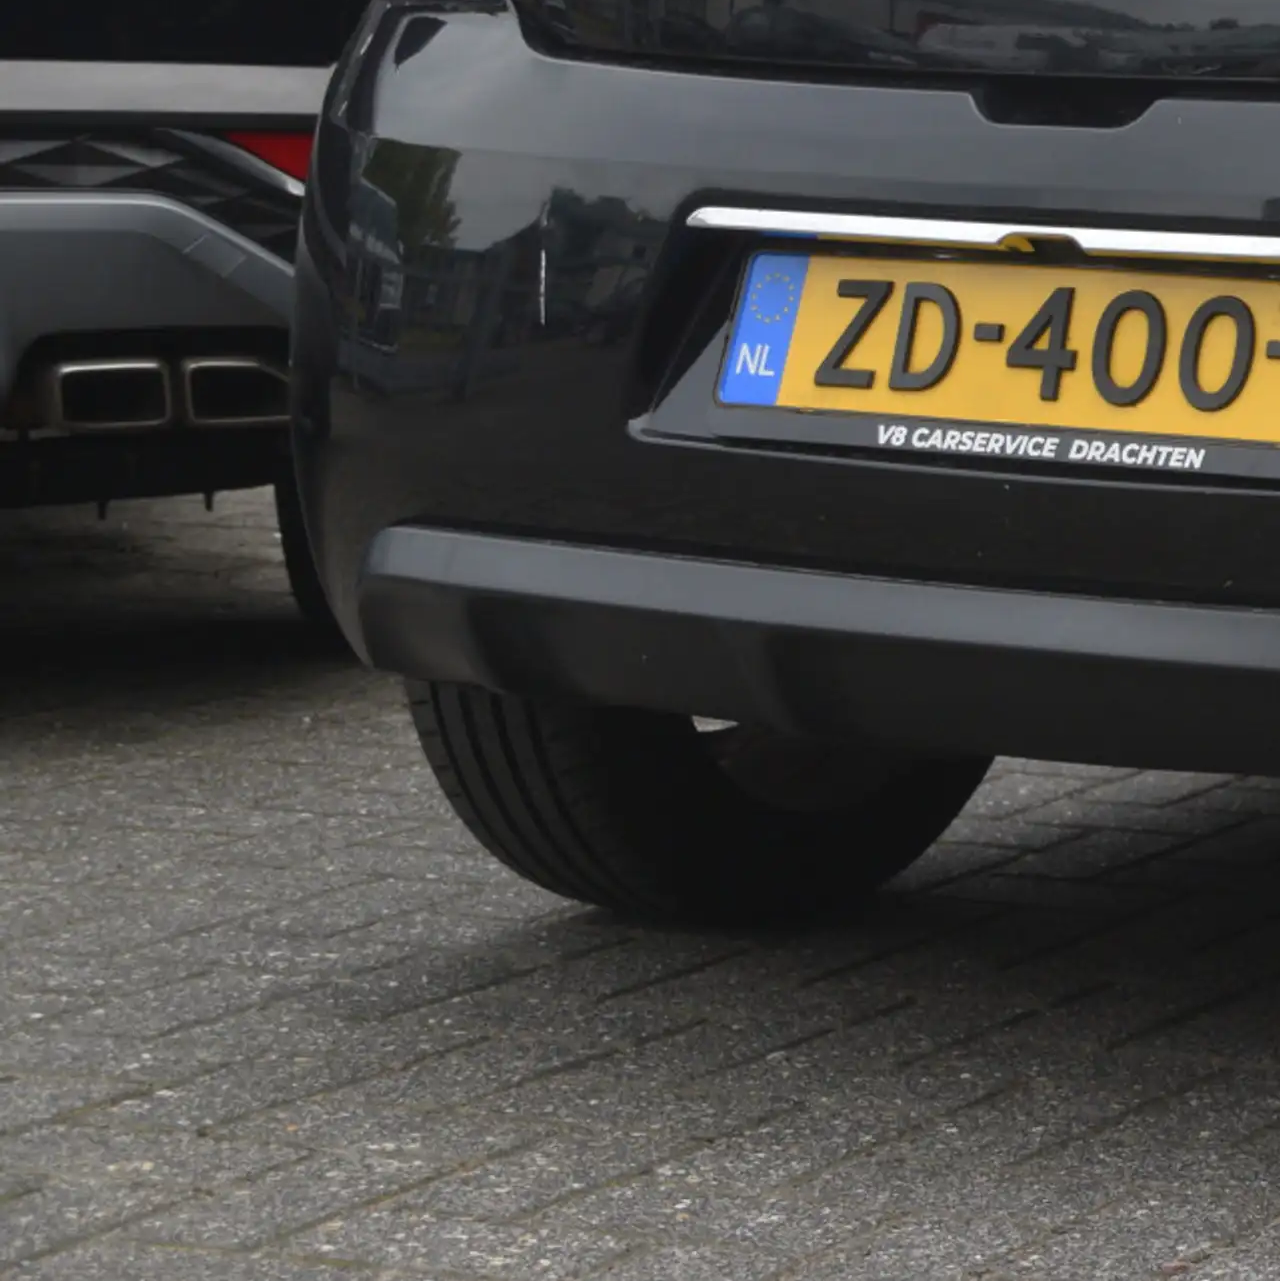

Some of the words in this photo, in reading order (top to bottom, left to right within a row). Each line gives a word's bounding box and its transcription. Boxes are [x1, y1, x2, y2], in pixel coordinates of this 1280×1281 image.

[735, 343, 775, 377] NL
[876, 424, 907, 447] V8
[911, 428, 1060, 458] CARSERVICE
[1067, 438, 1206, 469] DRACHTEN
